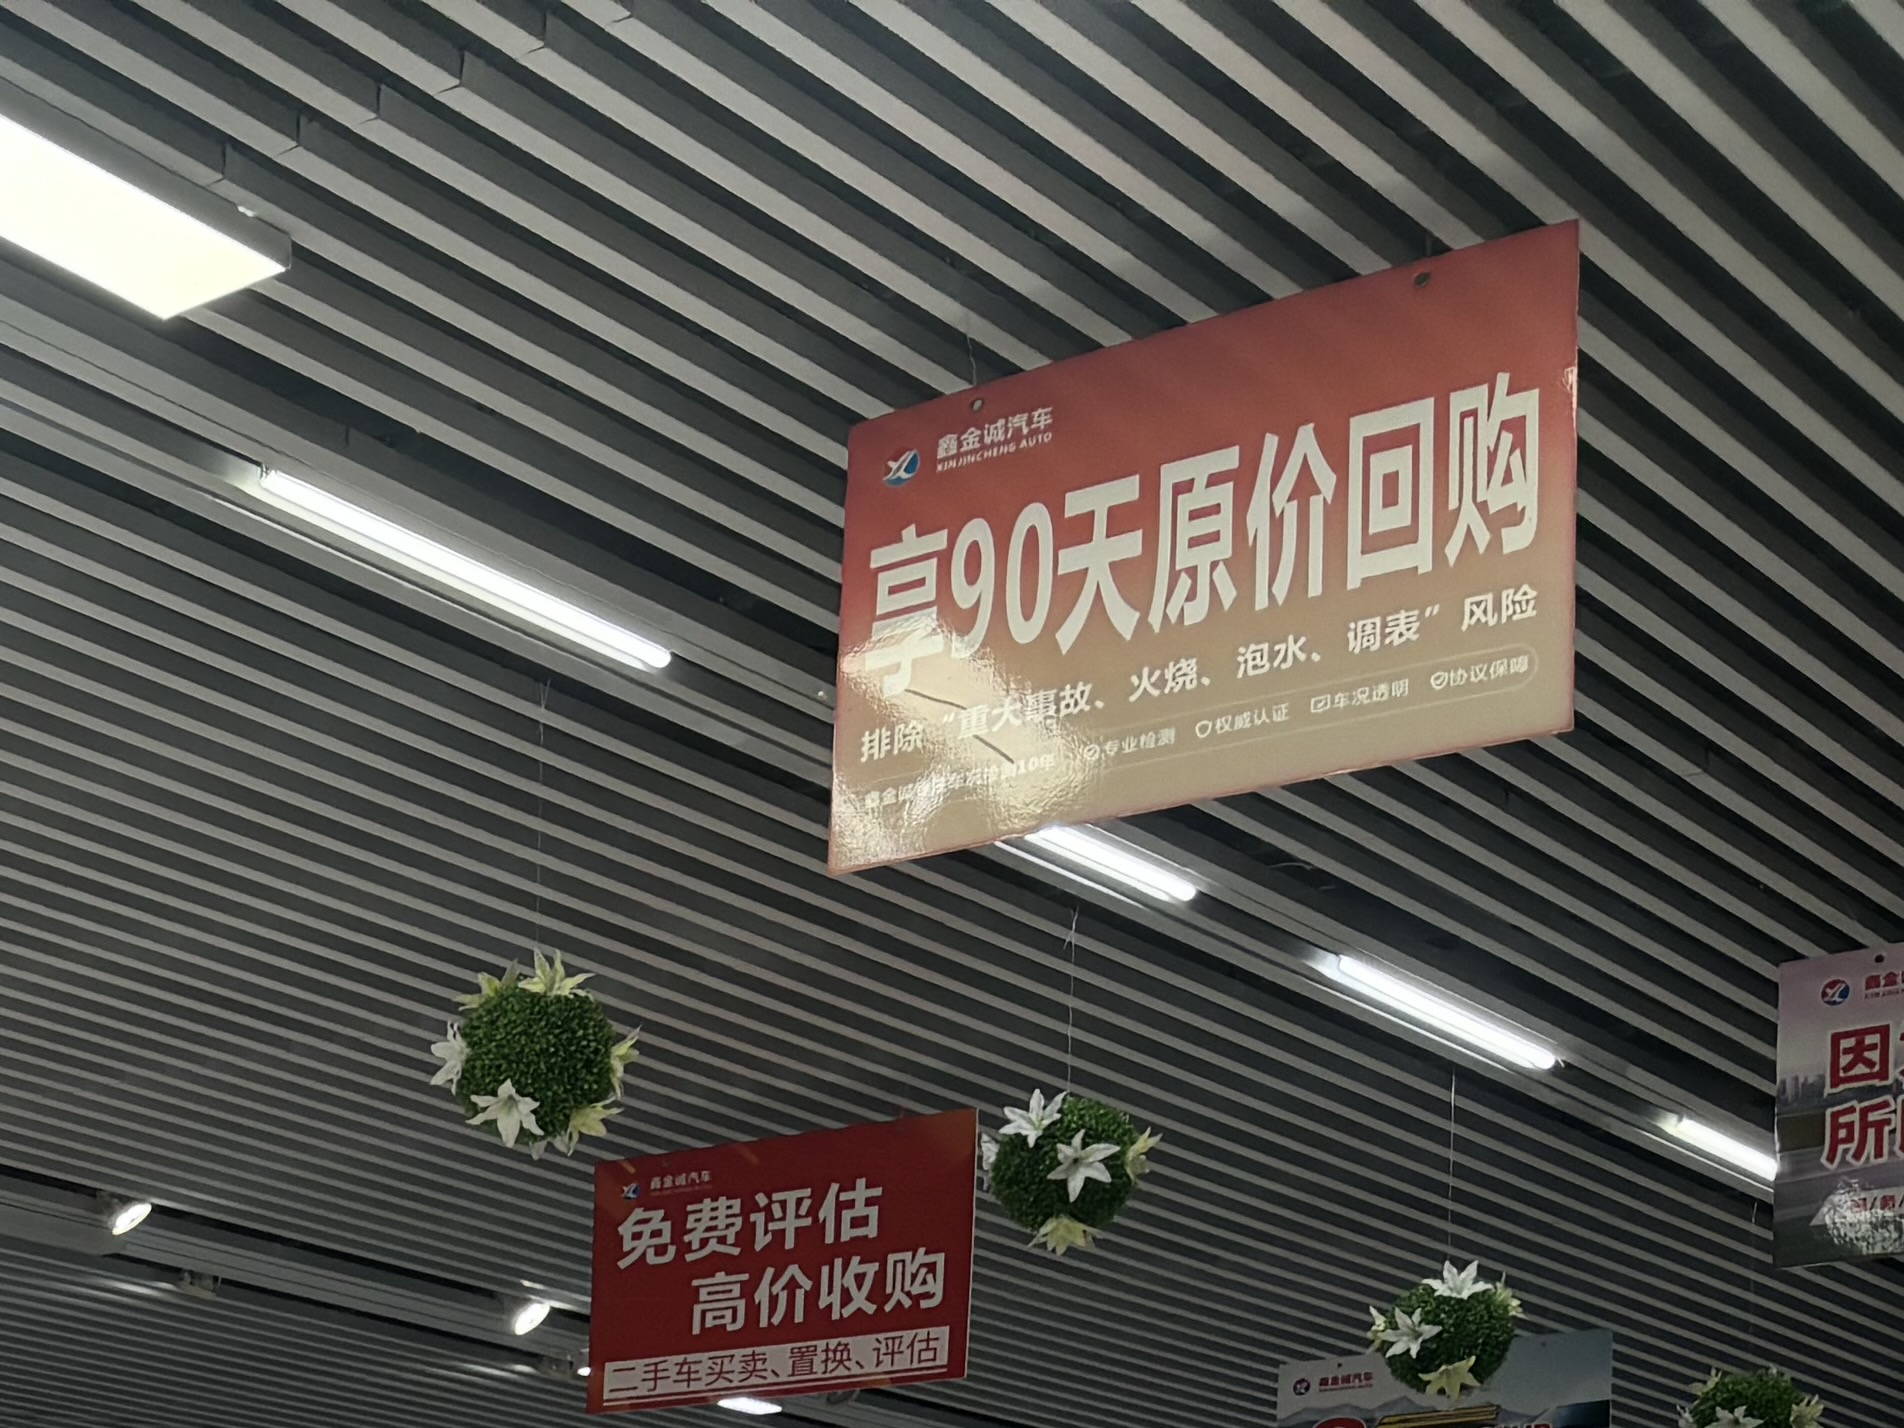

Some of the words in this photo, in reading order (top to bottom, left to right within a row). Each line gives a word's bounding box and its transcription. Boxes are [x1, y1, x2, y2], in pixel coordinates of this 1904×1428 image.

[937, 407, 1053, 459] 鑫金诚汽车
[1020, 432, 1052, 449] AUTO
[864, 373, 1541, 698] 享90天原价回购
[1333, 679, 1409, 709] 车况透明
[1449, 655, 1529, 688] 协议保障
[1216, 703, 1290, 735] 权威认证
[1829, 1023, 1904, 1089] 因
[1825, 1095, 1904, 1165] 所
[617, 1178, 883, 1269] 免费评估
[692, 1247, 945, 1335] 高价收购
[609, 1331, 939, 1394] 二手车买卖、置换、评估
